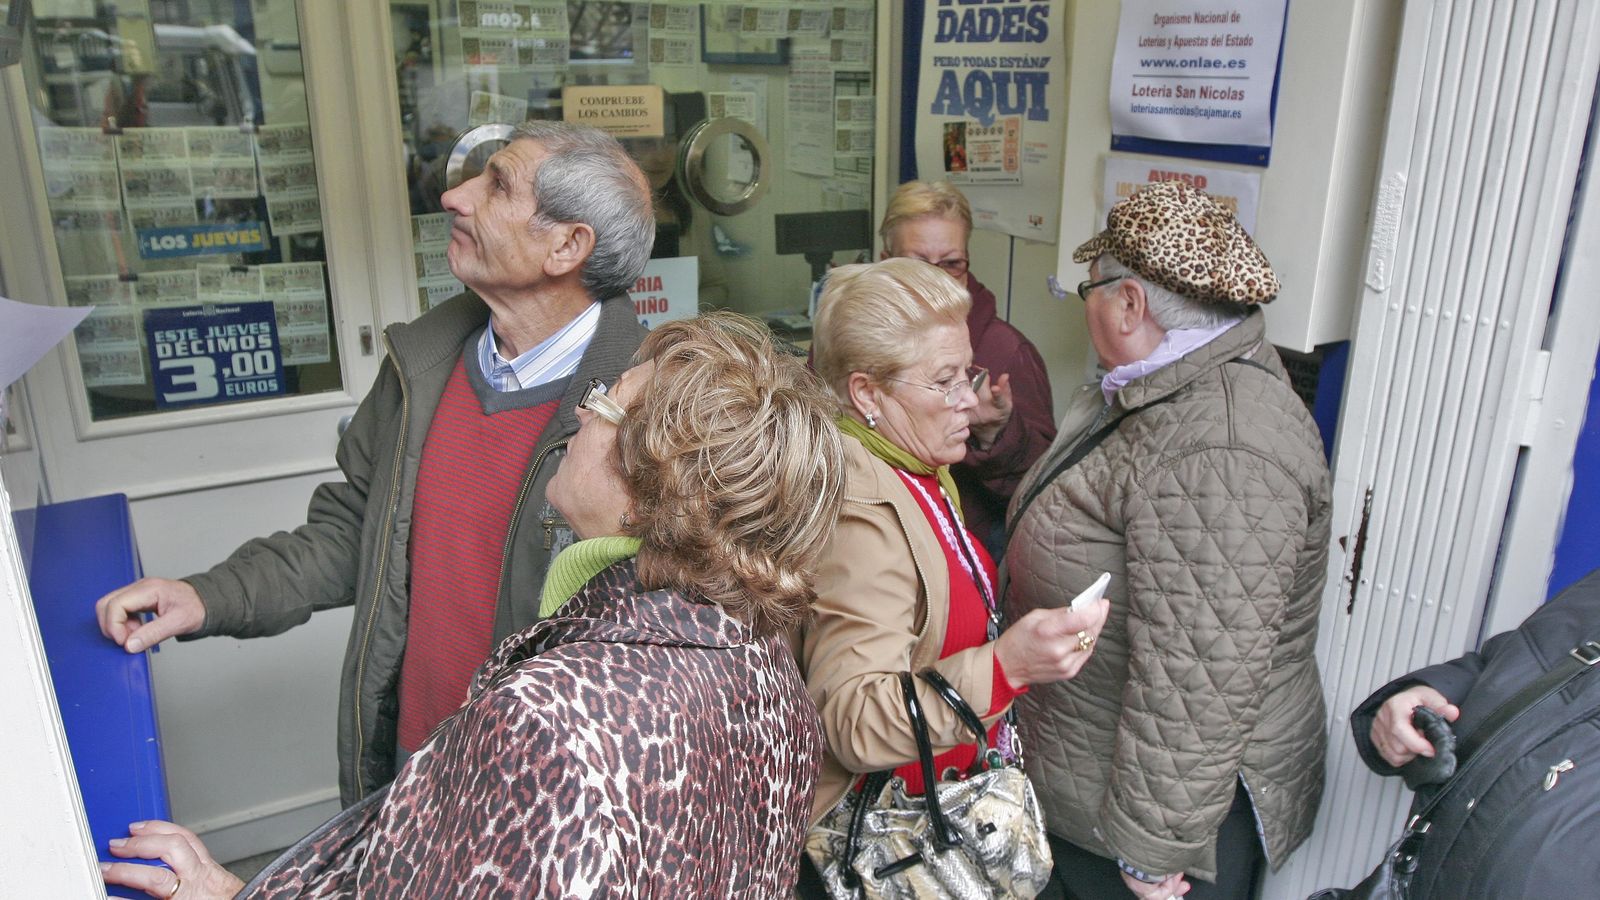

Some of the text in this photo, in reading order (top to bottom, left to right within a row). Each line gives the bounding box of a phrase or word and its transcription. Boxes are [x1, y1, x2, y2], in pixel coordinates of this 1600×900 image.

[934, 5, 1050, 43] DADES
[1153, 10, 1240, 28] Organismo Nacional de
[1167, 39, 1172, 50] y
[1174, 35, 1209, 49] Apuestas
[1211, 34, 1223, 47] del
[1226, 34, 1253, 47] Estado
[933, 56, 960, 67] PERO
[962, 57, 997, 68] TODAS
[1140, 56, 1247, 69] www.onlae.es
[580, 95, 646, 106] COMPRUEBE
[1175, 84, 1196, 99] San
[1200, 86, 1245, 102] Nicolas
[578, 108, 648, 118] LOS CAMBIOS
[1147, 169, 1207, 189] AVISO
[150, 229, 261, 251] LOS JUEVES
[154, 321, 271, 342] ESTE JUEVES
[225, 379, 279, 397] EUROS
